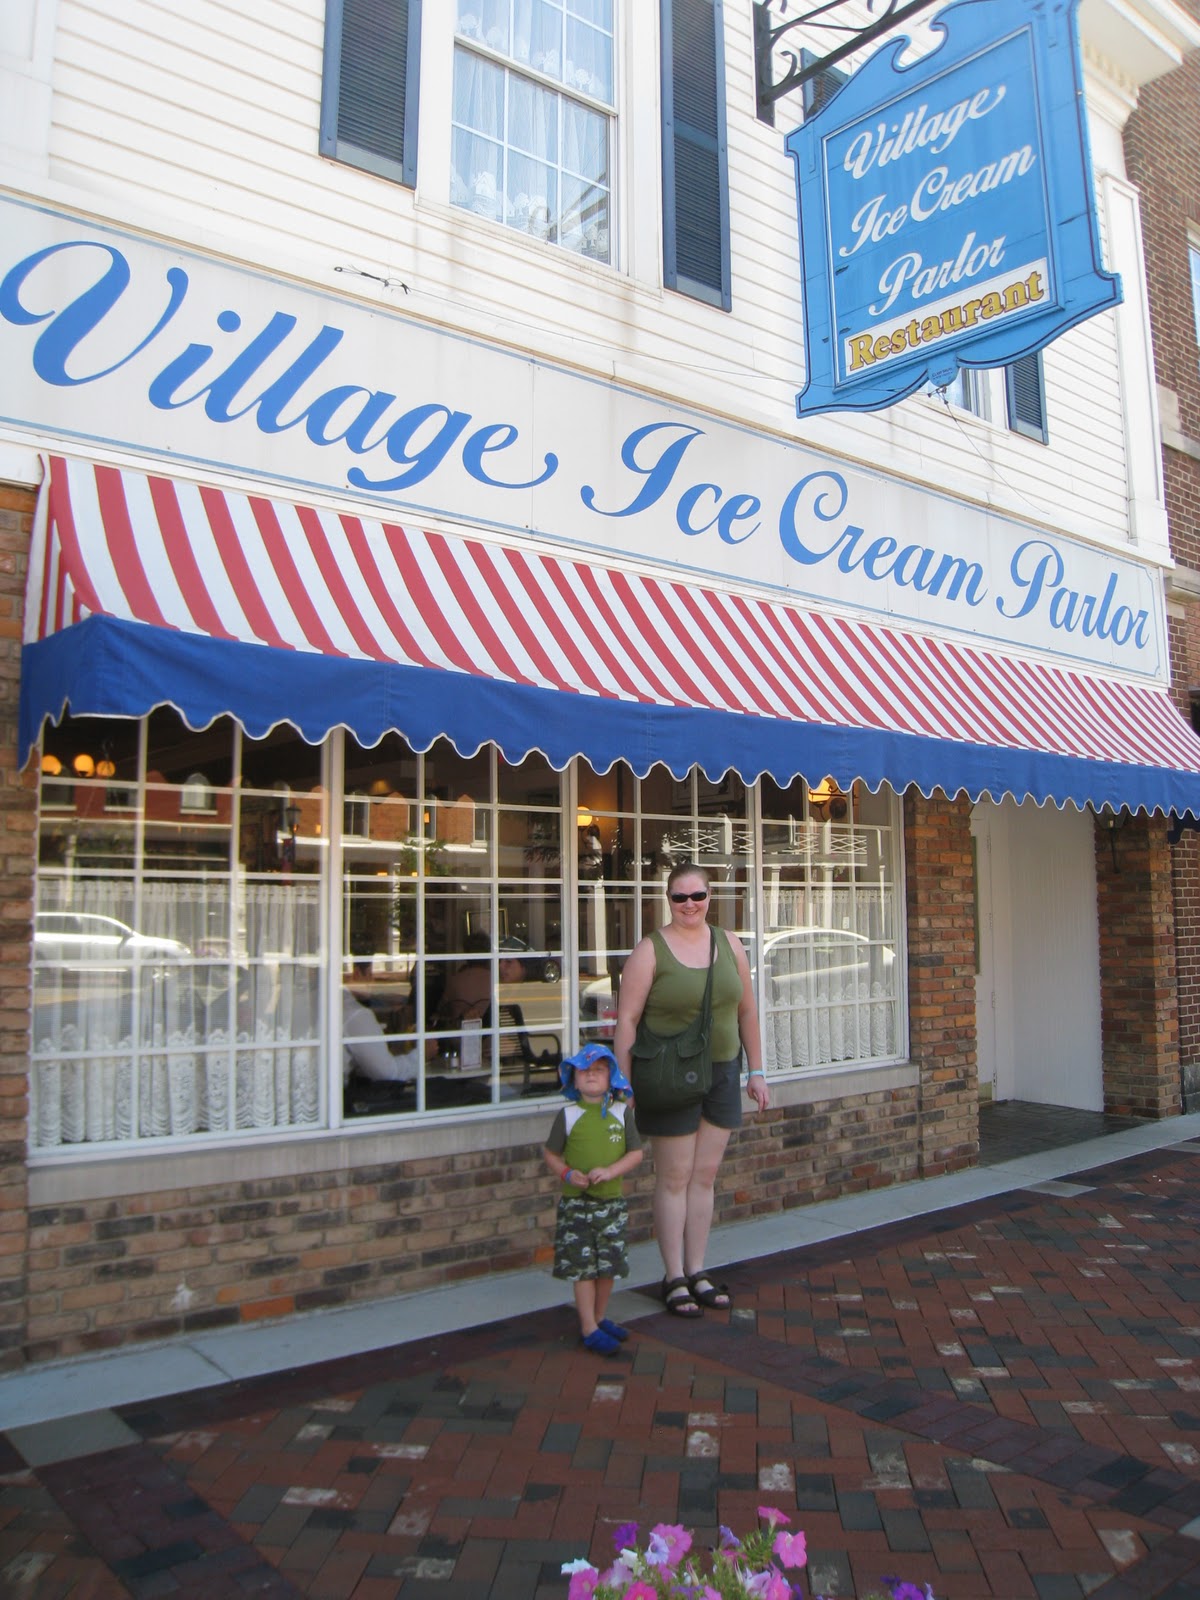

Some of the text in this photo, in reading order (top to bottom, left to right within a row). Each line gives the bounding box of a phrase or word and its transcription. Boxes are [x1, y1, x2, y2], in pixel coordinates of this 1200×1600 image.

[843, 86, 1006, 180] Village
[839, 144, 1037, 258] Ice Cream
[849, 270, 1045, 370] Restaurant
[868, 231, 1006, 316] Parlor
[0, 240, 1150, 650] Village Ice Cream Parlor
